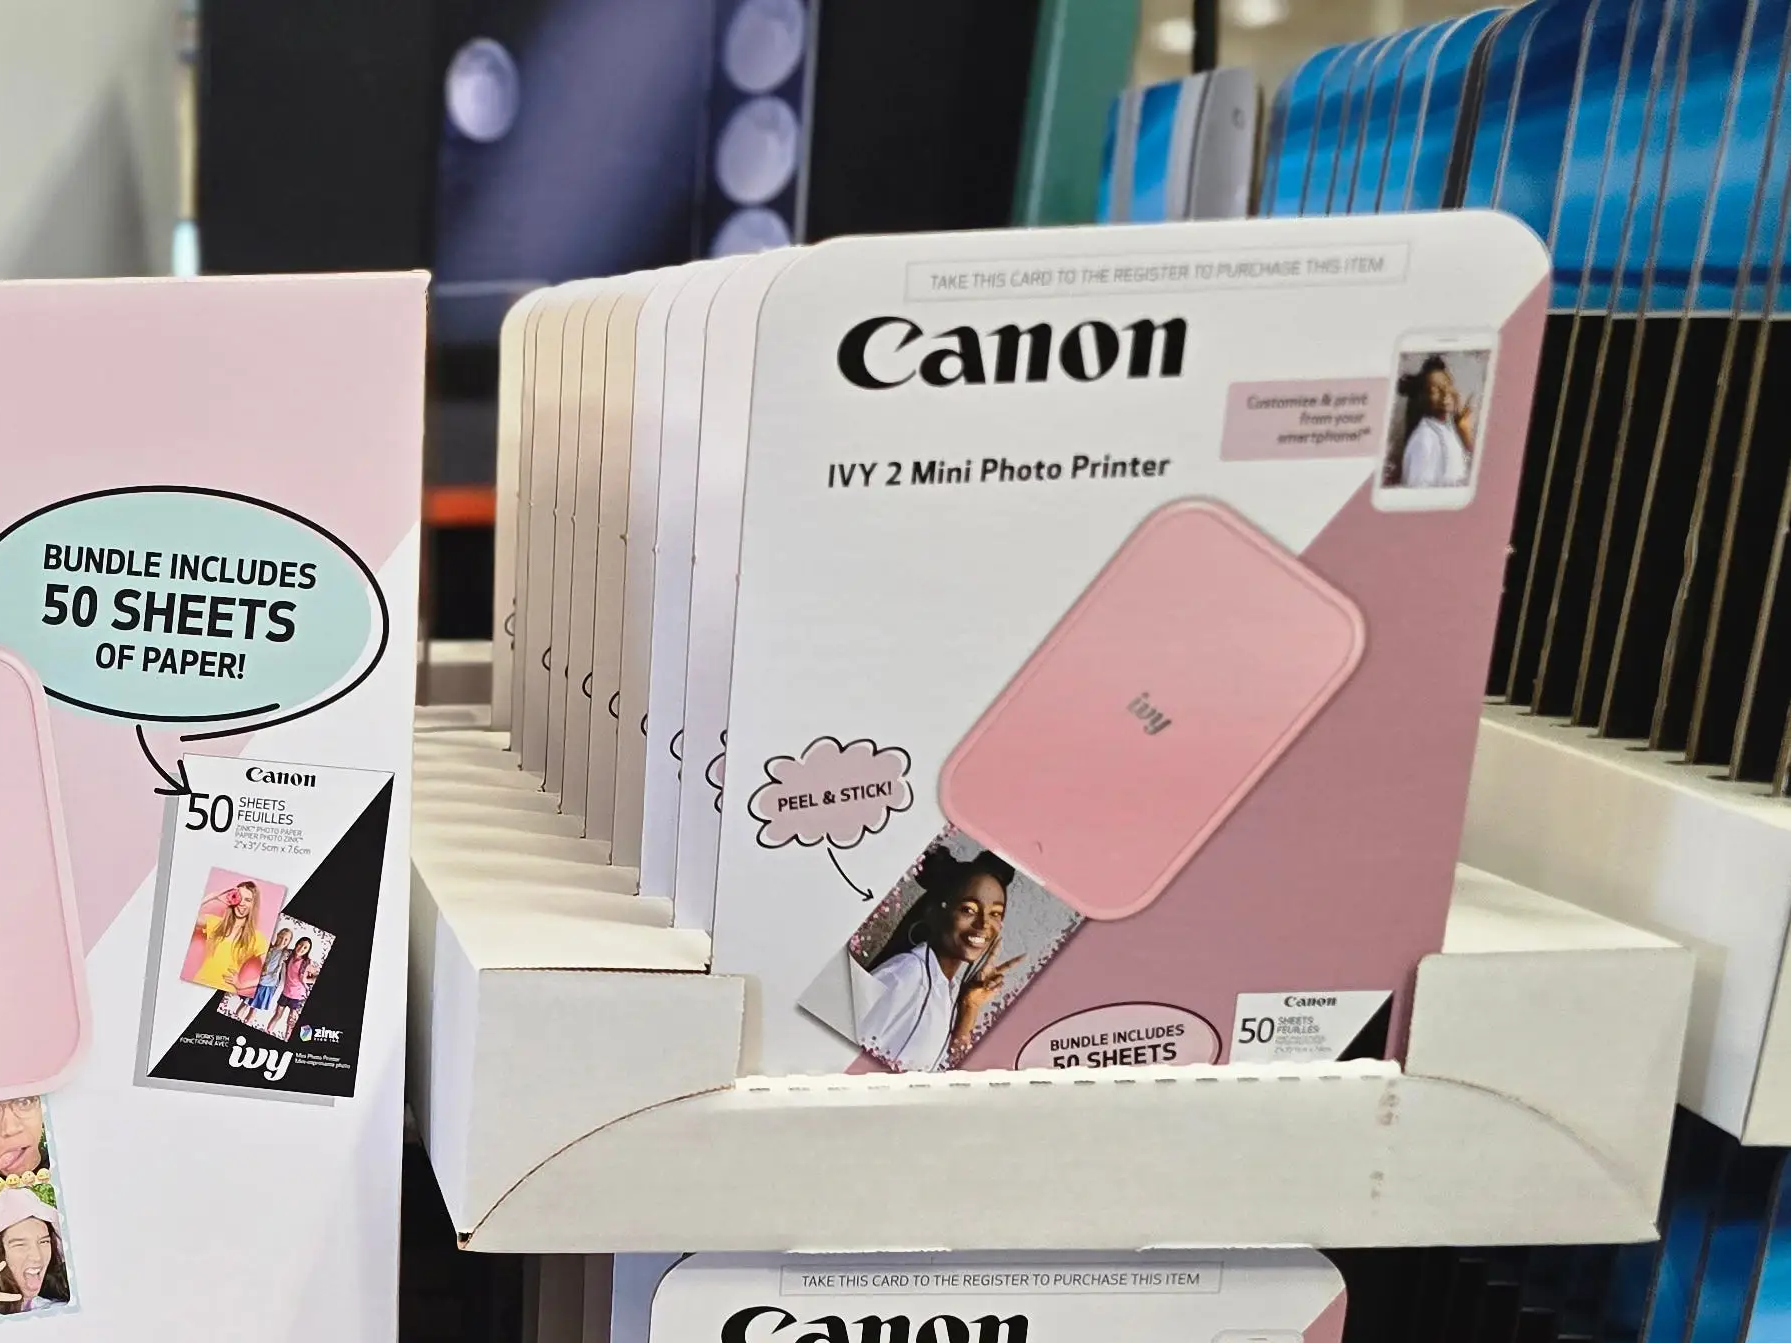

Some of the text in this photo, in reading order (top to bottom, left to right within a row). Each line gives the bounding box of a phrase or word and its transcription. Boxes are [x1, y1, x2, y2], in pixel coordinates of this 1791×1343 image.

[837, 316, 1187, 390] Canon
[829, 456, 1170, 488] IVY 2 Mini Photo Printer
[44, 544, 317, 589] BUNDLE INCLUDES
[42, 584, 297, 642] 50 SHEETS
[96, 643, 246, 679] OF PAPER!
[246, 767, 316, 787] Canon
[778, 781, 891, 812] PEEL & STICK!
[185, 792, 285, 833] 50 SHEETS
[238, 810, 293, 825] FEUILLES
[1284, 996, 1337, 1007] Canon
[1051, 1024, 1185, 1051] BUNDLE INCLUDES
[1239, 1018, 1275, 1044] 50
[229, 1036, 293, 1081] ivy
[1087, 1042, 1177, 1068] SHEETS
